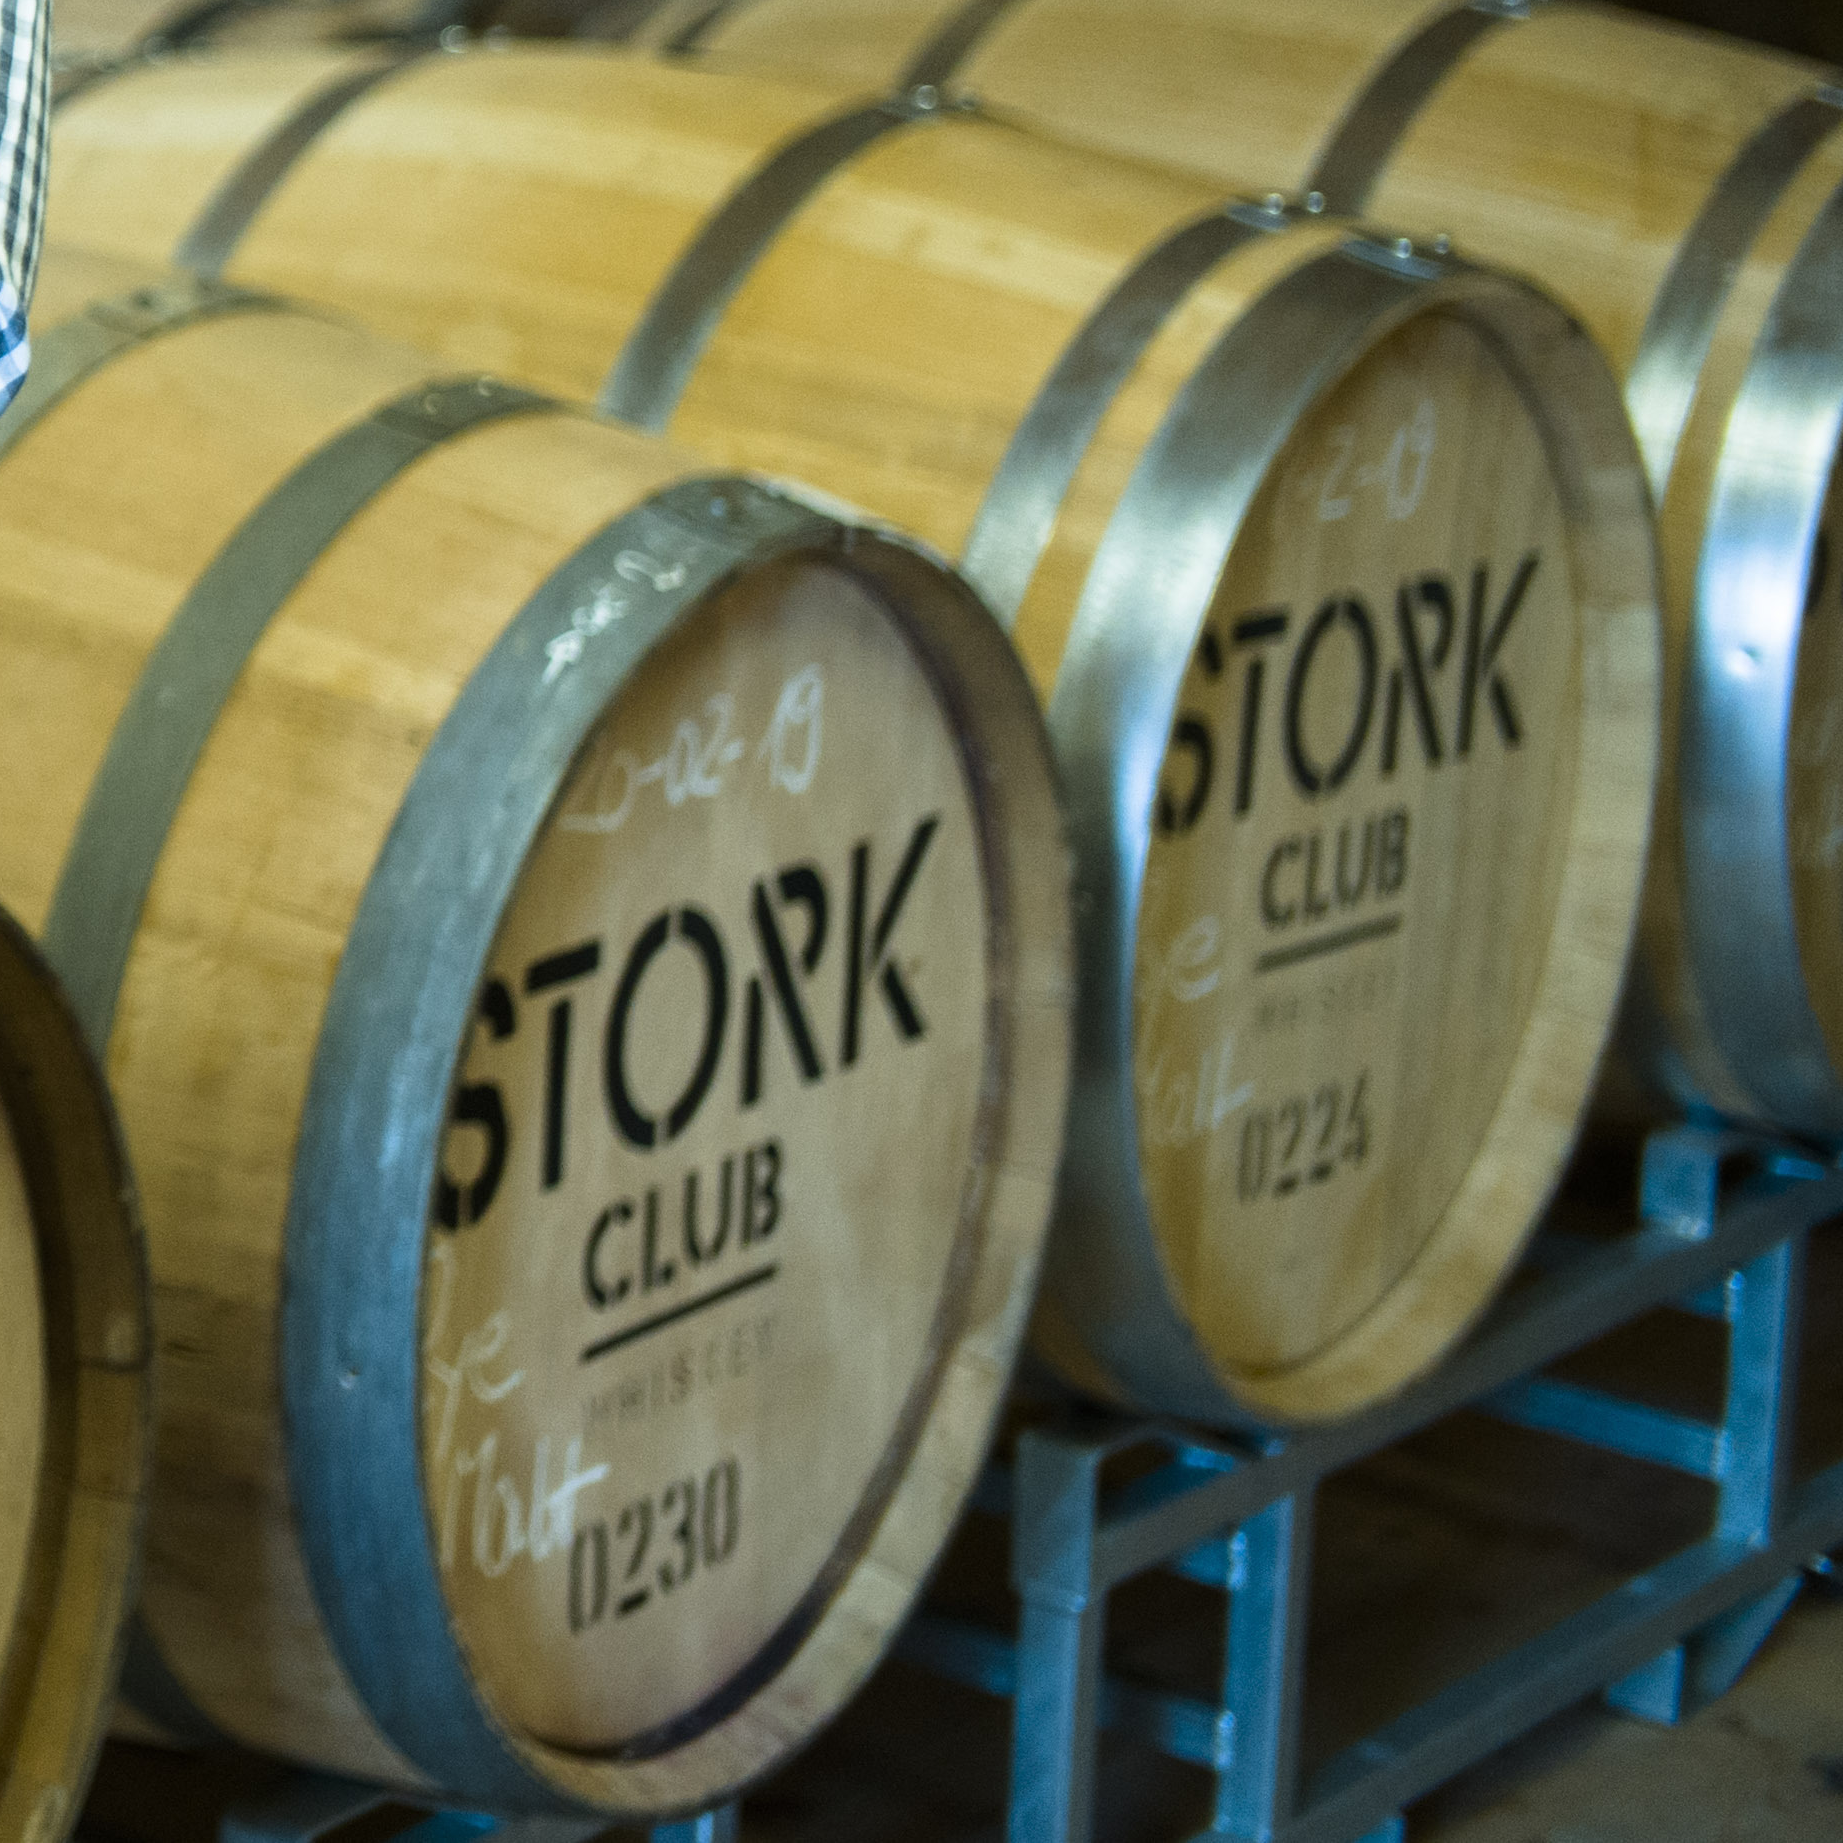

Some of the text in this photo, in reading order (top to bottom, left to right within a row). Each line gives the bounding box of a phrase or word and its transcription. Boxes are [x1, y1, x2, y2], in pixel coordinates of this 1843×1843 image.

[1157, 548, 1540, 838] STORK
[1258, 805, 1410, 930] CLUB
[430, 813, 940, 1236] STORK
[582, 1136, 783, 1311] CLUB
[565, 1452, 744, 1636] 0230
